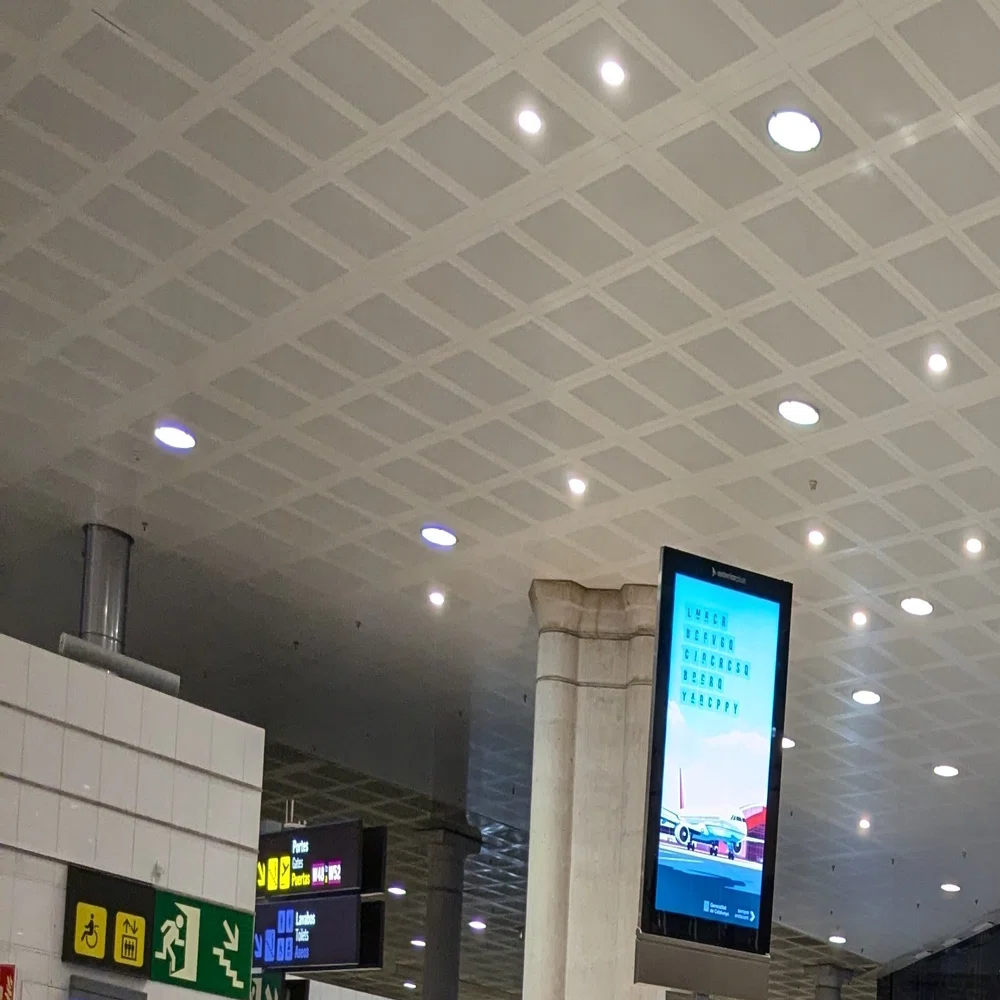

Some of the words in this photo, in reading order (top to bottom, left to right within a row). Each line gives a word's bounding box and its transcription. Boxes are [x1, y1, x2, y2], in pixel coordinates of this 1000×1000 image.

[291, 873, 310, 886] Puertas
[295, 911, 316, 926] Lavabos
[295, 928, 309, 942] Toilets
